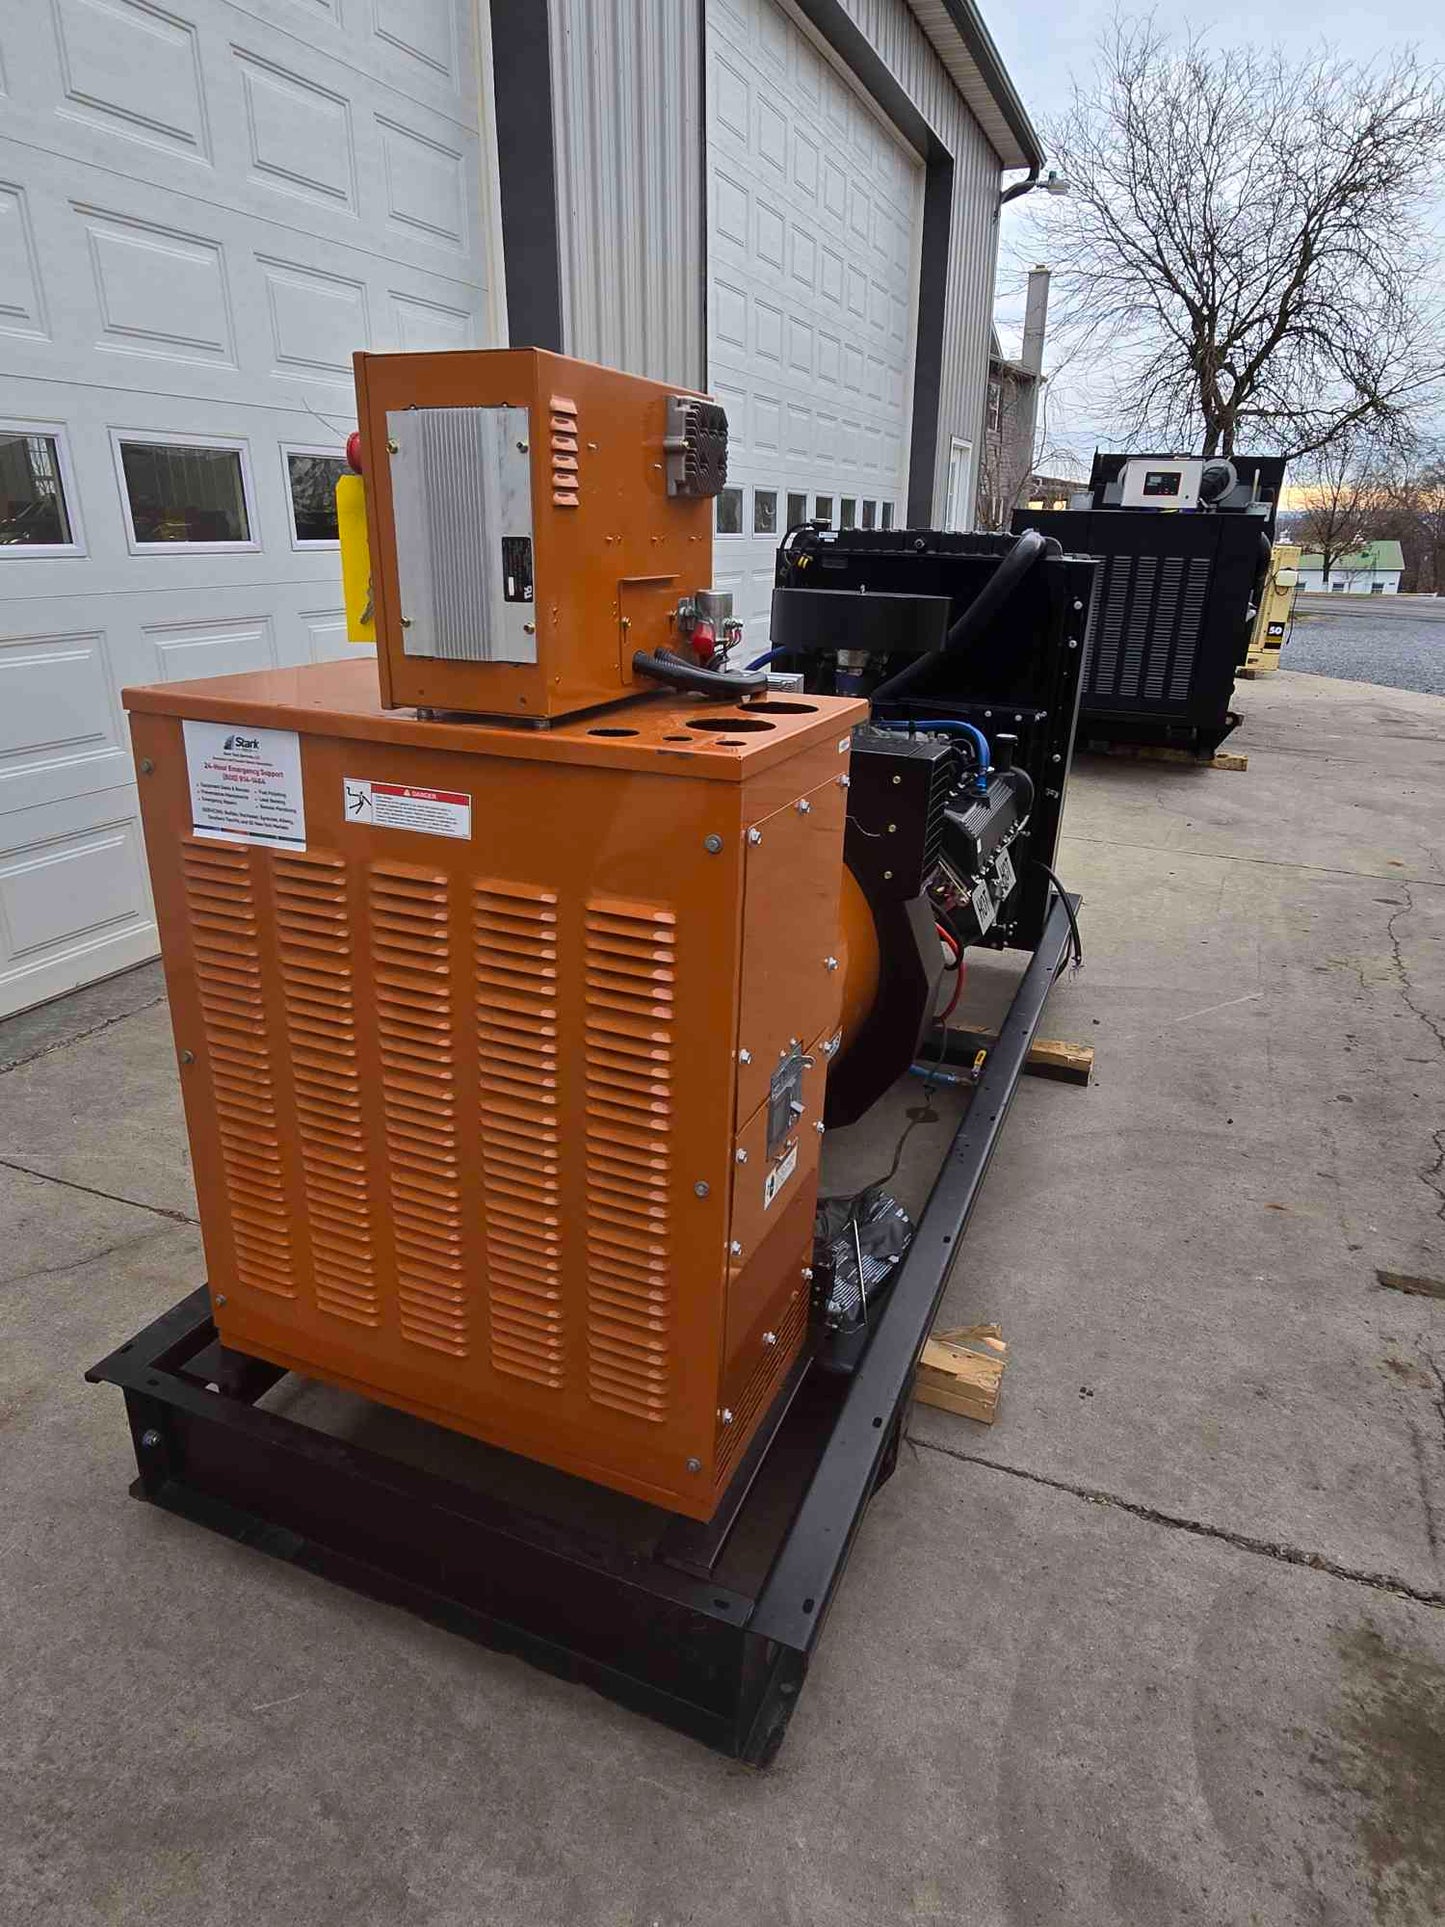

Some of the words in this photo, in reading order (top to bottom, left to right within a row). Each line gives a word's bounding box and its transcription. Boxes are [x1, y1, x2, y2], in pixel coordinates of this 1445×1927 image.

[1268, 626, 1282, 635] 50
[235, 737, 259, 749] Stark
[227, 765, 260, 776] Emergency
[260, 769, 283, 778] Support
